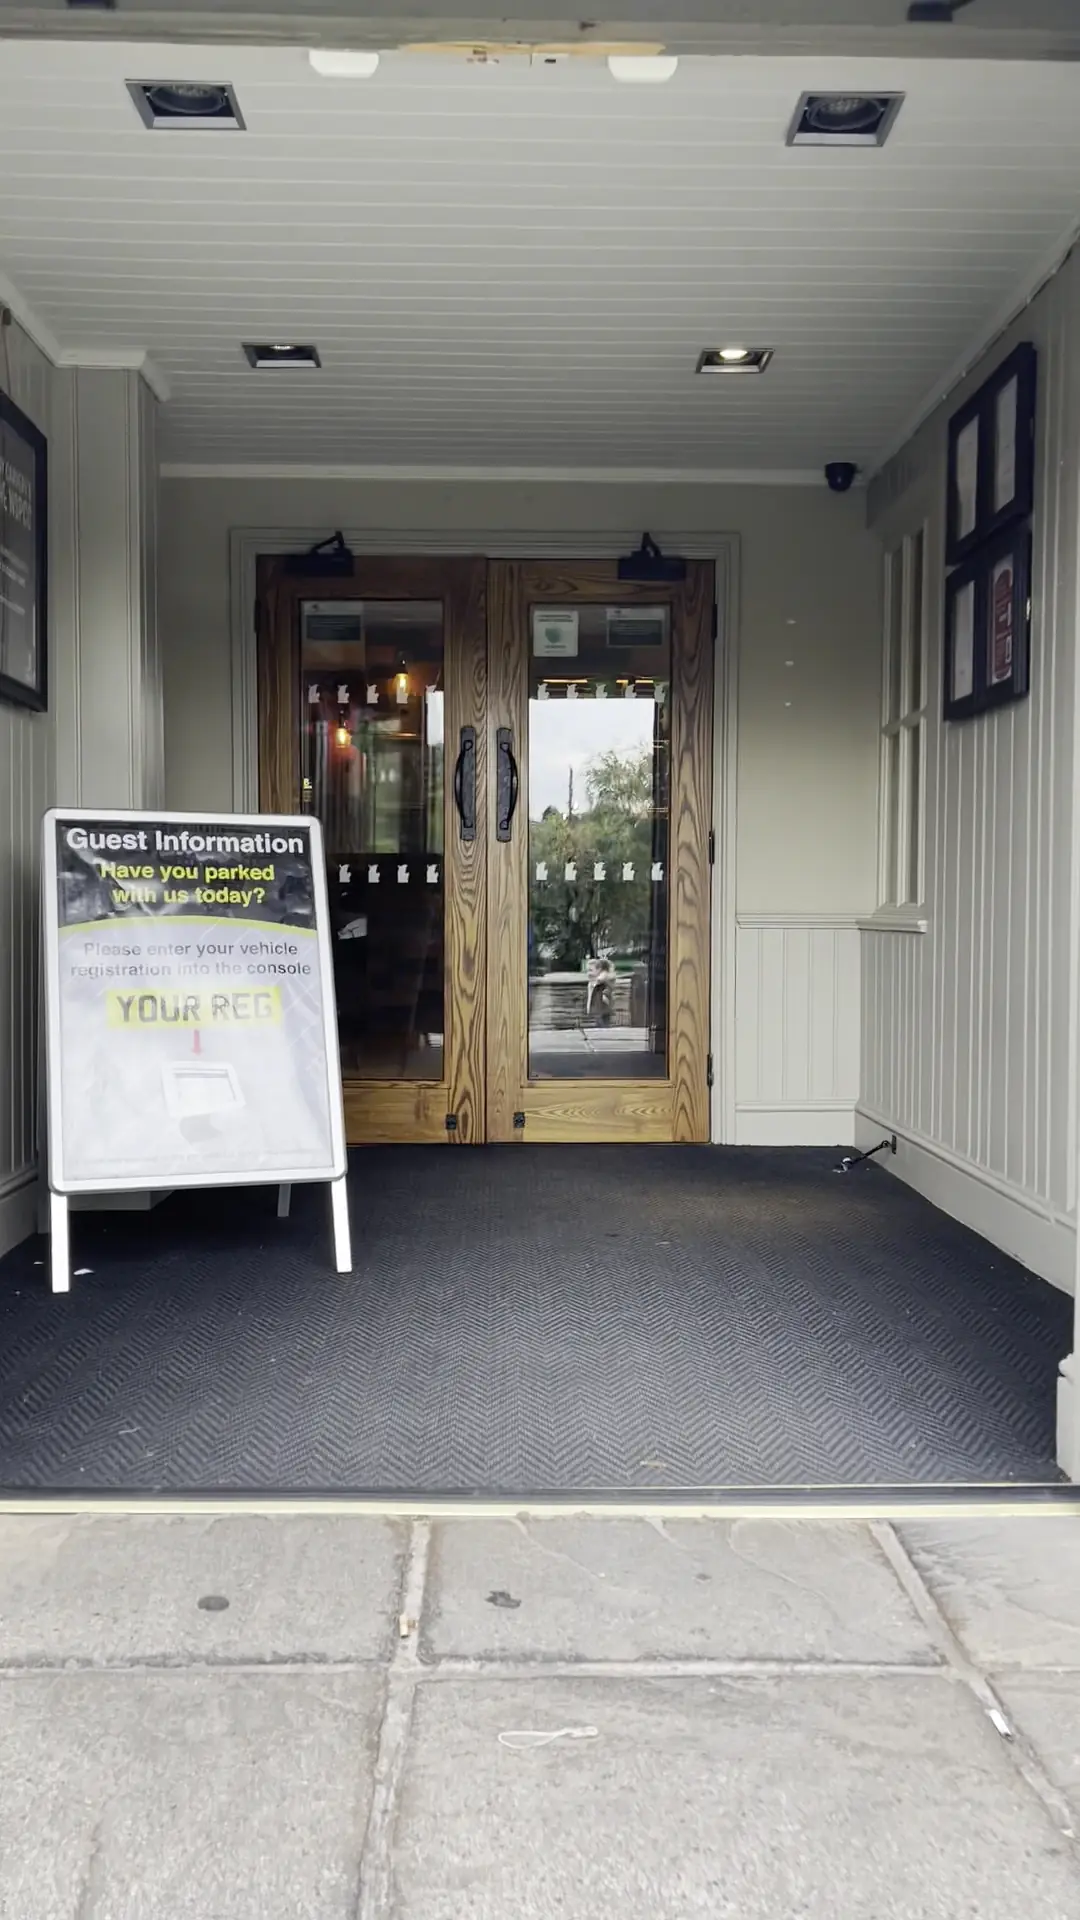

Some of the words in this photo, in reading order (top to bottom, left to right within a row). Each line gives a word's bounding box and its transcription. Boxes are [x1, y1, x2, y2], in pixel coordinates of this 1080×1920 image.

[66, 827, 148, 851] Guest
[155, 830, 304, 854] Information
[99, 863, 154, 879] Have
[160, 867, 198, 885] you
[205, 864, 275, 884] parked
[112, 888, 157, 903] with
[164, 890, 189, 903] us
[195, 887, 266, 907] today?
[84, 942, 142, 957] Please
[147, 945, 191, 957] enter
[196, 944, 235, 960] your
[240, 941, 298, 956] vehicle
[70, 961, 172, 980] registration
[177, 962, 210, 976] into
[216, 962, 241, 975] the
[247, 961, 311, 976] console
[116, 994, 201, 1023] YOUR
[211, 992, 273, 1021] REG
